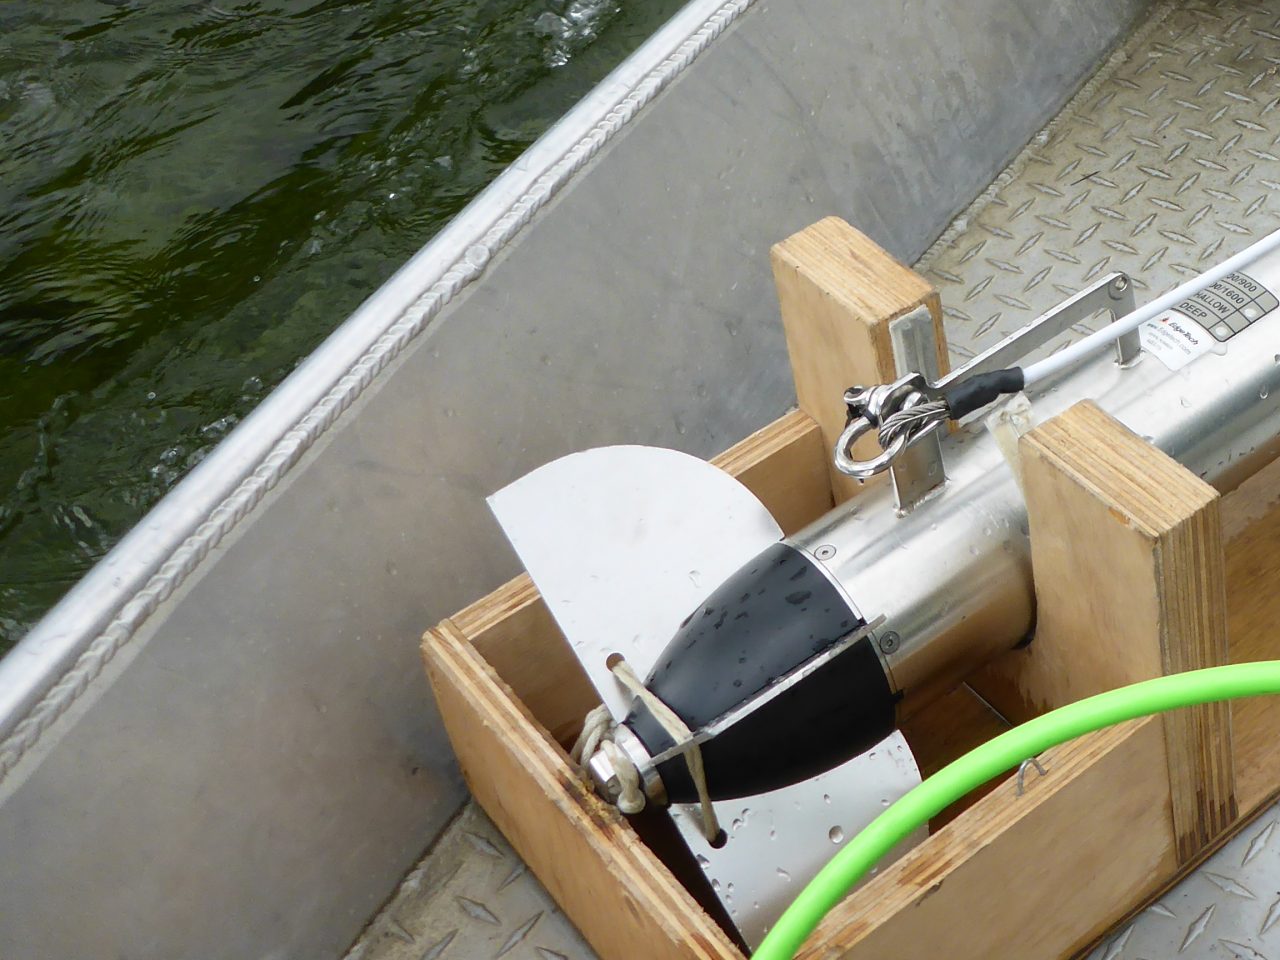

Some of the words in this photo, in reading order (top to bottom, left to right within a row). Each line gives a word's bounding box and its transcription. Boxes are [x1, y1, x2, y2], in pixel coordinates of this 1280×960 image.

[1227, 273, 1257, 292] 00/900
[1193, 291, 1230, 314] HALLOW
[1208, 282, 1244, 304] 00/1600
[1179, 302, 1208, 318] DEEP
